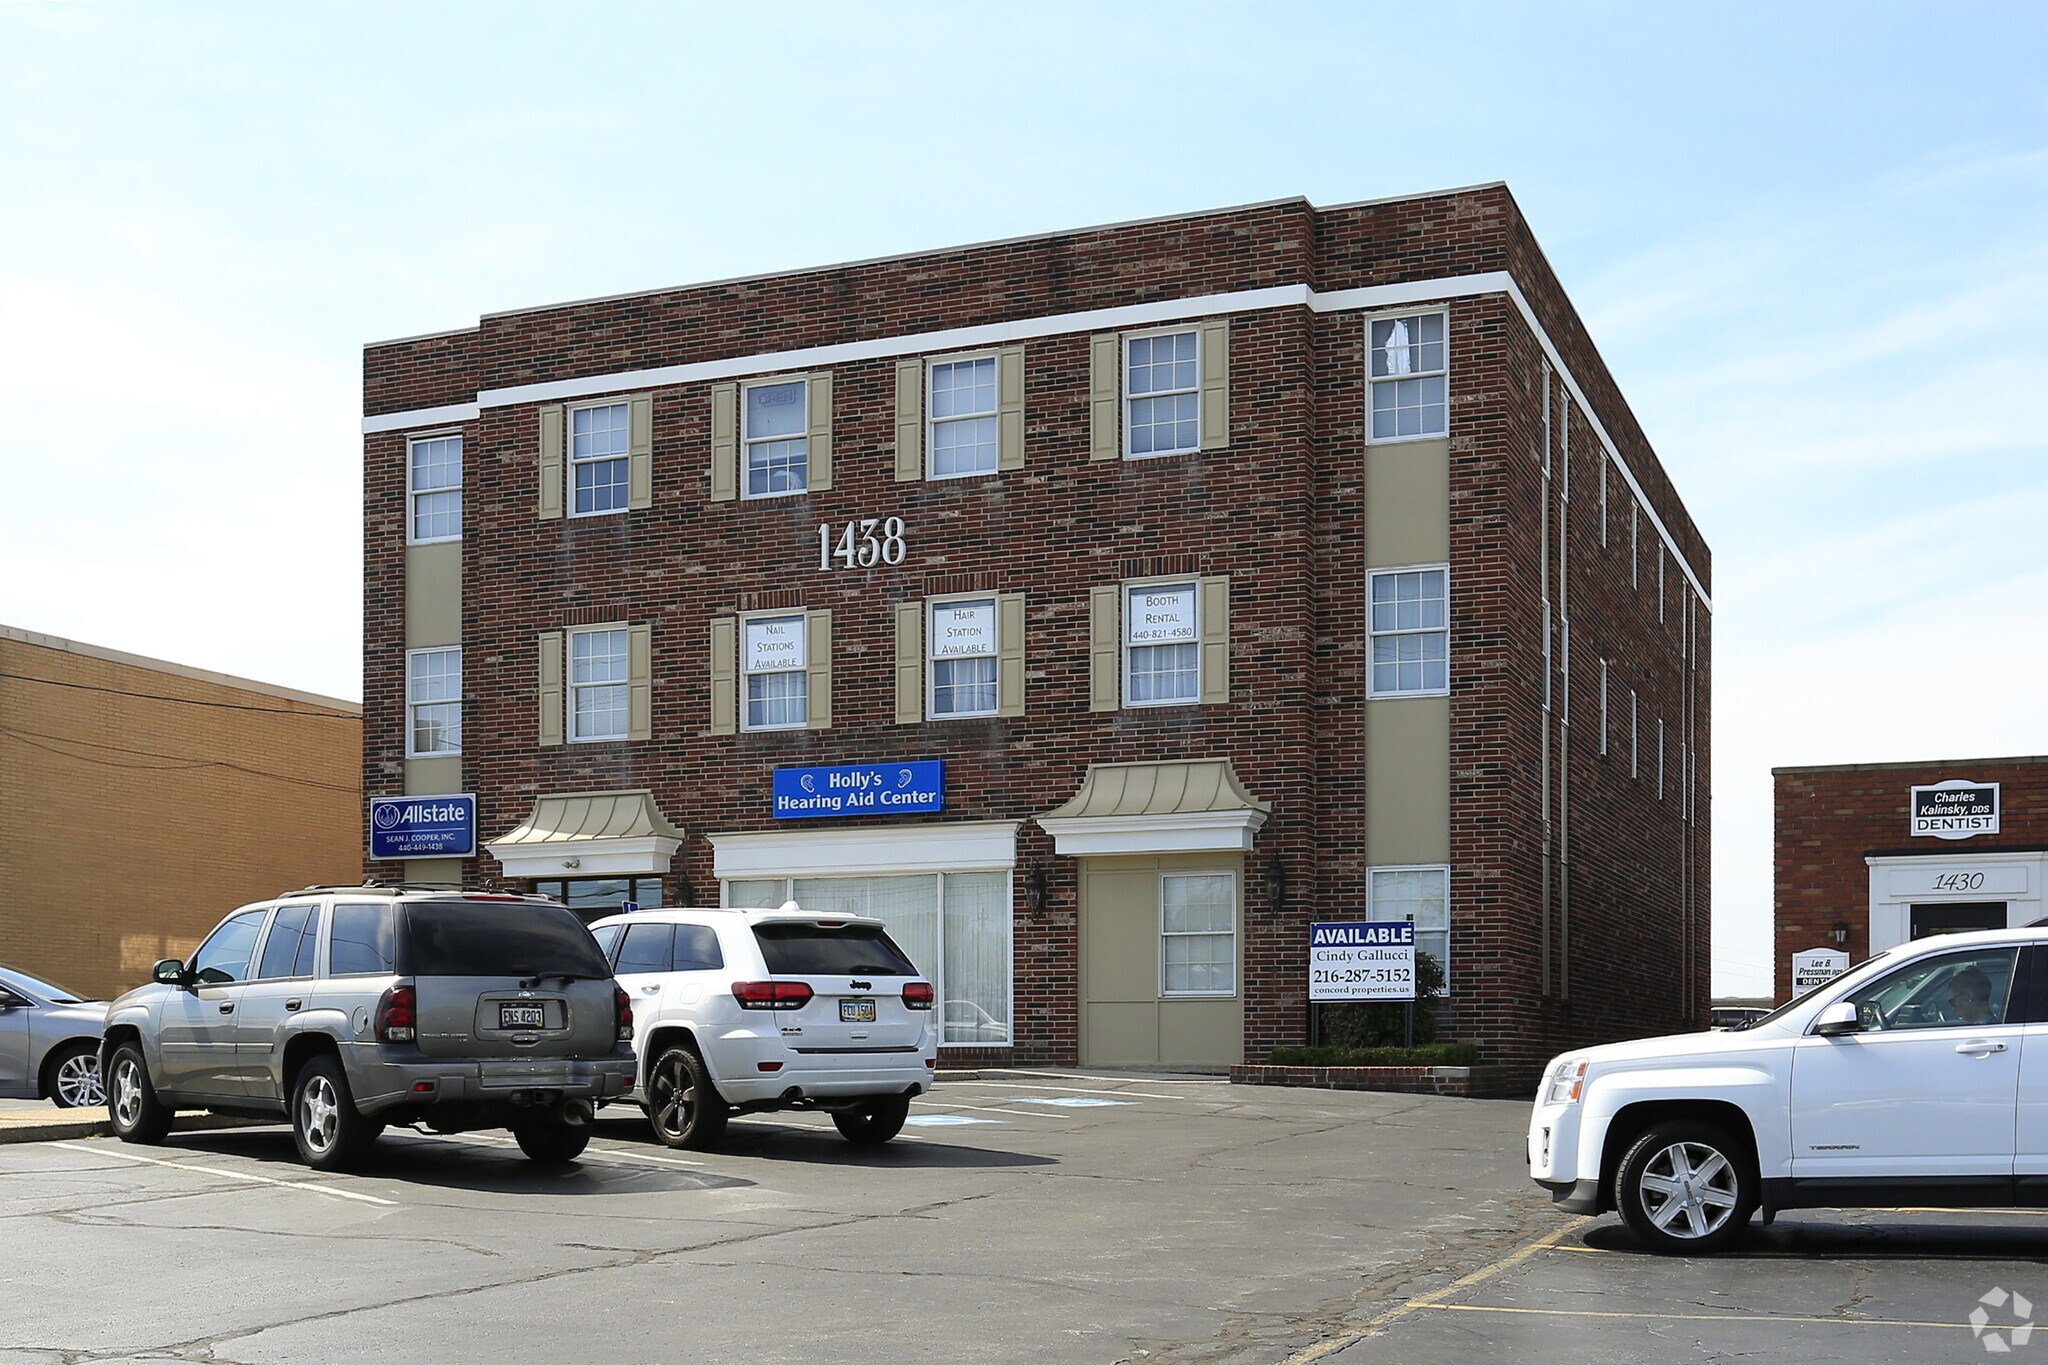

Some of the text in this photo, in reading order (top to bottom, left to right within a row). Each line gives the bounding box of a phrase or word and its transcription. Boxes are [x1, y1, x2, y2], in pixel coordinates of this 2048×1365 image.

[818, 516, 907, 571] 1438
[1146, 596, 1179, 607] BOOTH
[953, 610, 975, 620] HAIR
[1145, 613, 1180, 624] RENTAL
[766, 625, 785, 635] NAIL
[946, 627, 982, 637] STATION
[1133, 627, 1192, 639] 440-821-4580
[757, 641, 795, 652] STATIONS
[942, 643, 987, 654] AVAILABLE
[754, 657, 797, 669] AVAILABLE
[829, 771, 882, 790] Holly's
[778, 790, 937, 811] Hearing Aid Center
[1934, 791, 1976, 803] Charles
[400, 803, 465, 824] Allstate
[1920, 803, 1990, 816] Kalinsky, DDS
[1917, 817, 1993, 831] DENTIST
[386, 835, 404, 843] SEAN
[411, 833, 440, 842] COOPER,
[441, 832, 456, 841] INC.
[398, 843, 443, 852] 440-449-1438
[1932, 872, 1985, 891] 1430
[1313, 927, 1412, 944] AVAILABLE
[1316, 949, 1408, 964] Cindy Gallucci
[1811, 959, 1824, 967] Lee
[1313, 968, 1411, 983] 216-287-5152
[1351, 985, 1410, 995] properties.us
